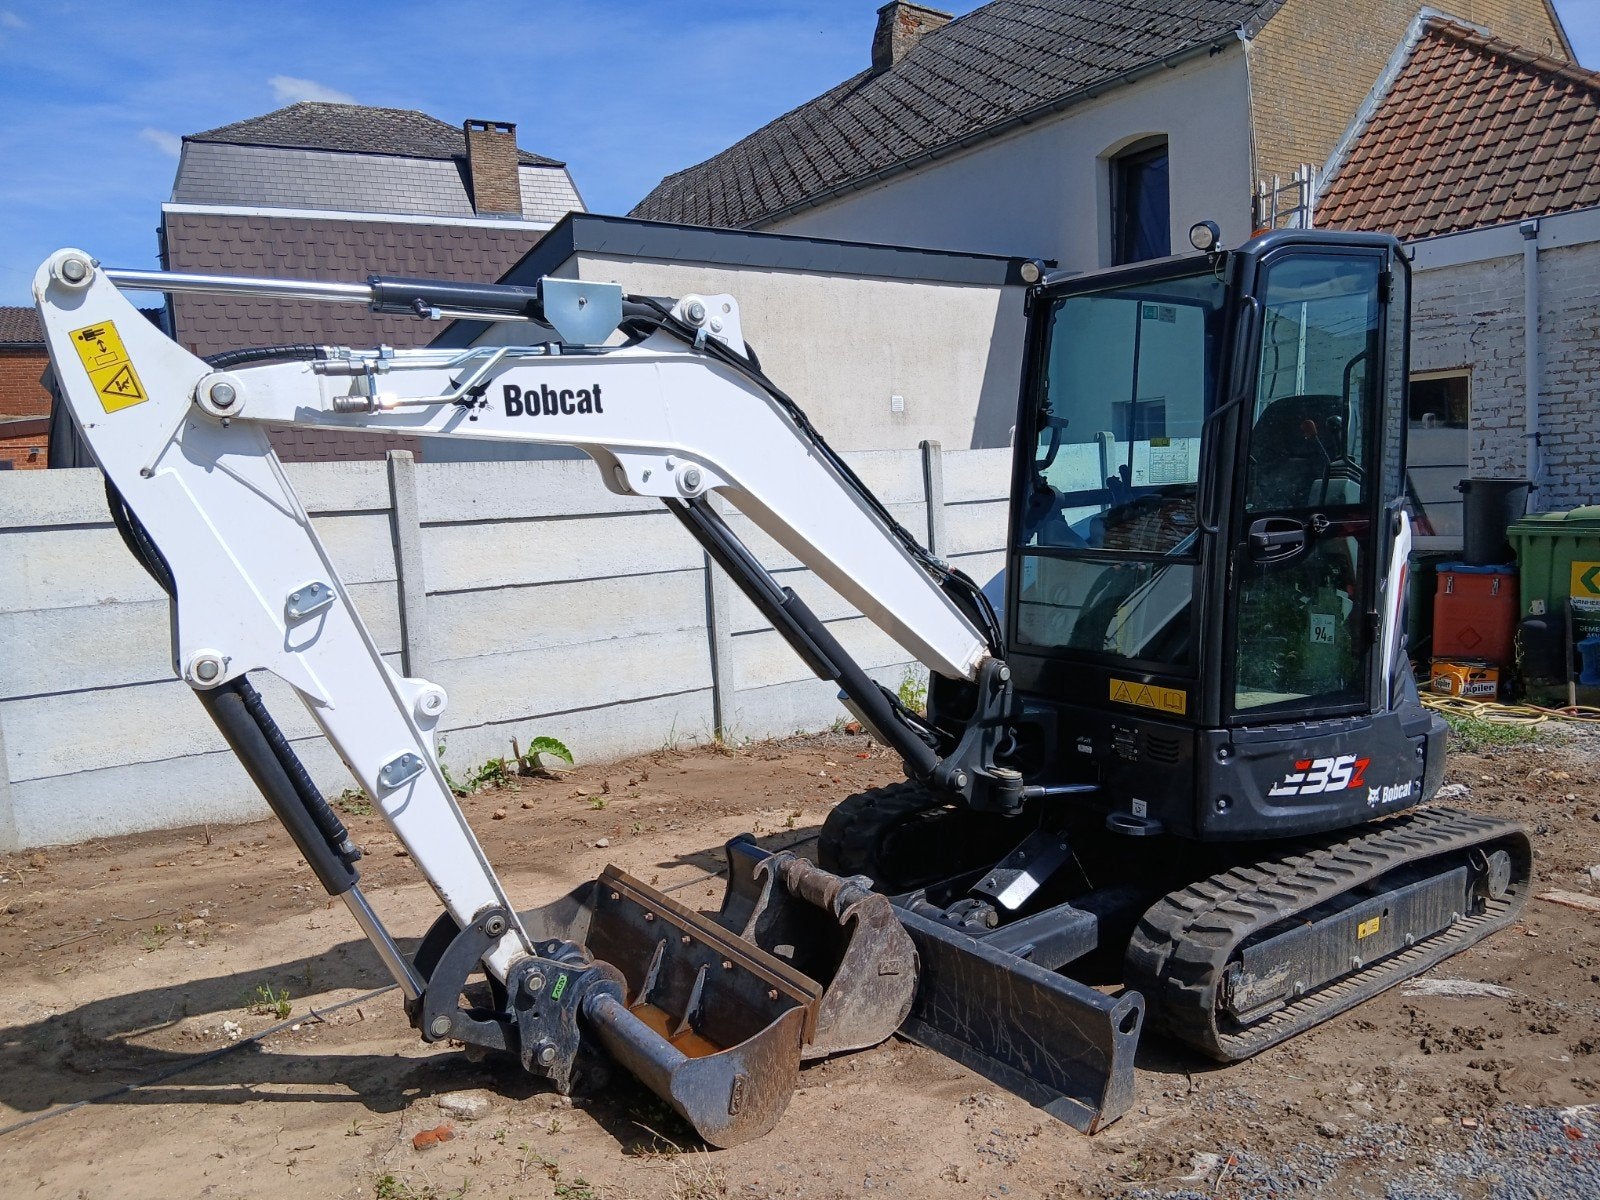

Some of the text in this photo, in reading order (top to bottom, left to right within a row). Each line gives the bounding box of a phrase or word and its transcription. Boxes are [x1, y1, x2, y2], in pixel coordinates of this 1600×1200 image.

[503, 384, 603, 416] Bobcat
[1315, 627, 1326, 641] 94
[1382, 780, 1412, 803] Bobcat
